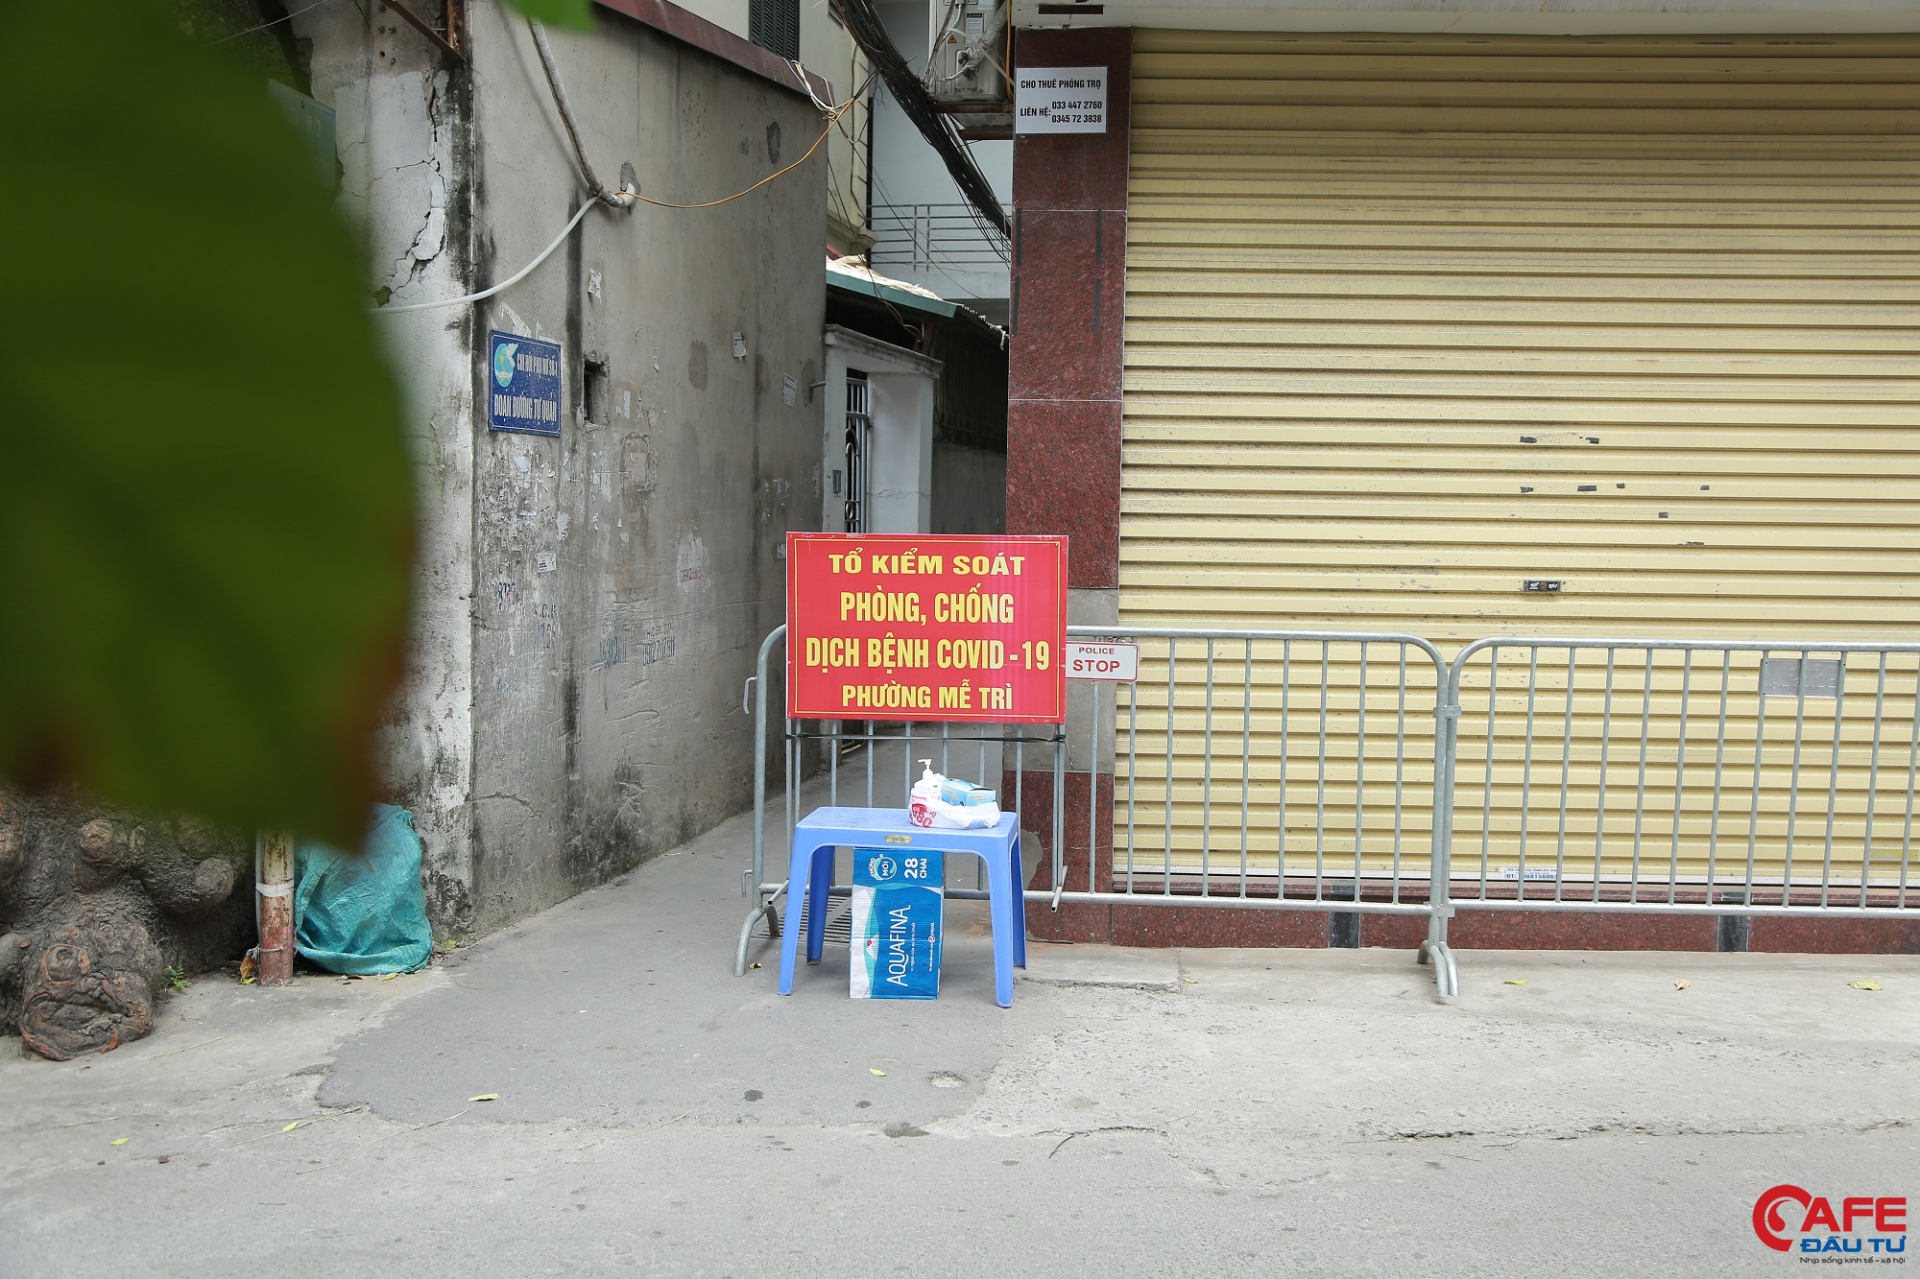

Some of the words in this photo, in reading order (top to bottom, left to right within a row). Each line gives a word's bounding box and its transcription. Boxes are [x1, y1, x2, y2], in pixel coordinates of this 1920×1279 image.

[1020, 79, 1036, 89] CHO
[1038, 77, 1057, 89] THUÊ
[1058, 77, 1085, 88] PHÒNG
[1087, 79, 1101, 90] TRỌ
[1020, 106, 1037, 117] LIÊN
[1039, 106, 1051, 118] HỆ:
[1051, 101, 1066, 110] 033
[1068, 101, 1082, 109] 447
[1083, 101, 1102, 109] 2760
[1051, 114, 1070, 123] 0345
[1072, 114, 1082, 123] 72
[1083, 114, 1102, 123] 3838
[517, 353, 525, 372] CHI
[494, 394, 512, 423] ĐOẠN
[828, 546, 864, 575] TỔ
[872, 546, 943, 575] KIỂM
[952, 552, 1026, 576] SOÁT
[840, 584, 927, 626] PHÒNG,
[934, 582, 1014, 624] CHỐNG
[805, 636, 860, 674] DỊCH
[867, 631, 929, 675] BỆNH
[1078, 646, 1116, 655] POLICE
[1072, 658, 1121, 673] STOP
[842, 679, 931, 709] PHƯỜNG
[938, 678, 971, 709] MỄ
[978, 683, 1013, 710] TRÌ
[881, 860, 889, 876] MỚI
[904, 857, 919, 879] 28
[919, 858, 928, 879] CHAI
[886, 904, 911, 987] AQUAFINA
